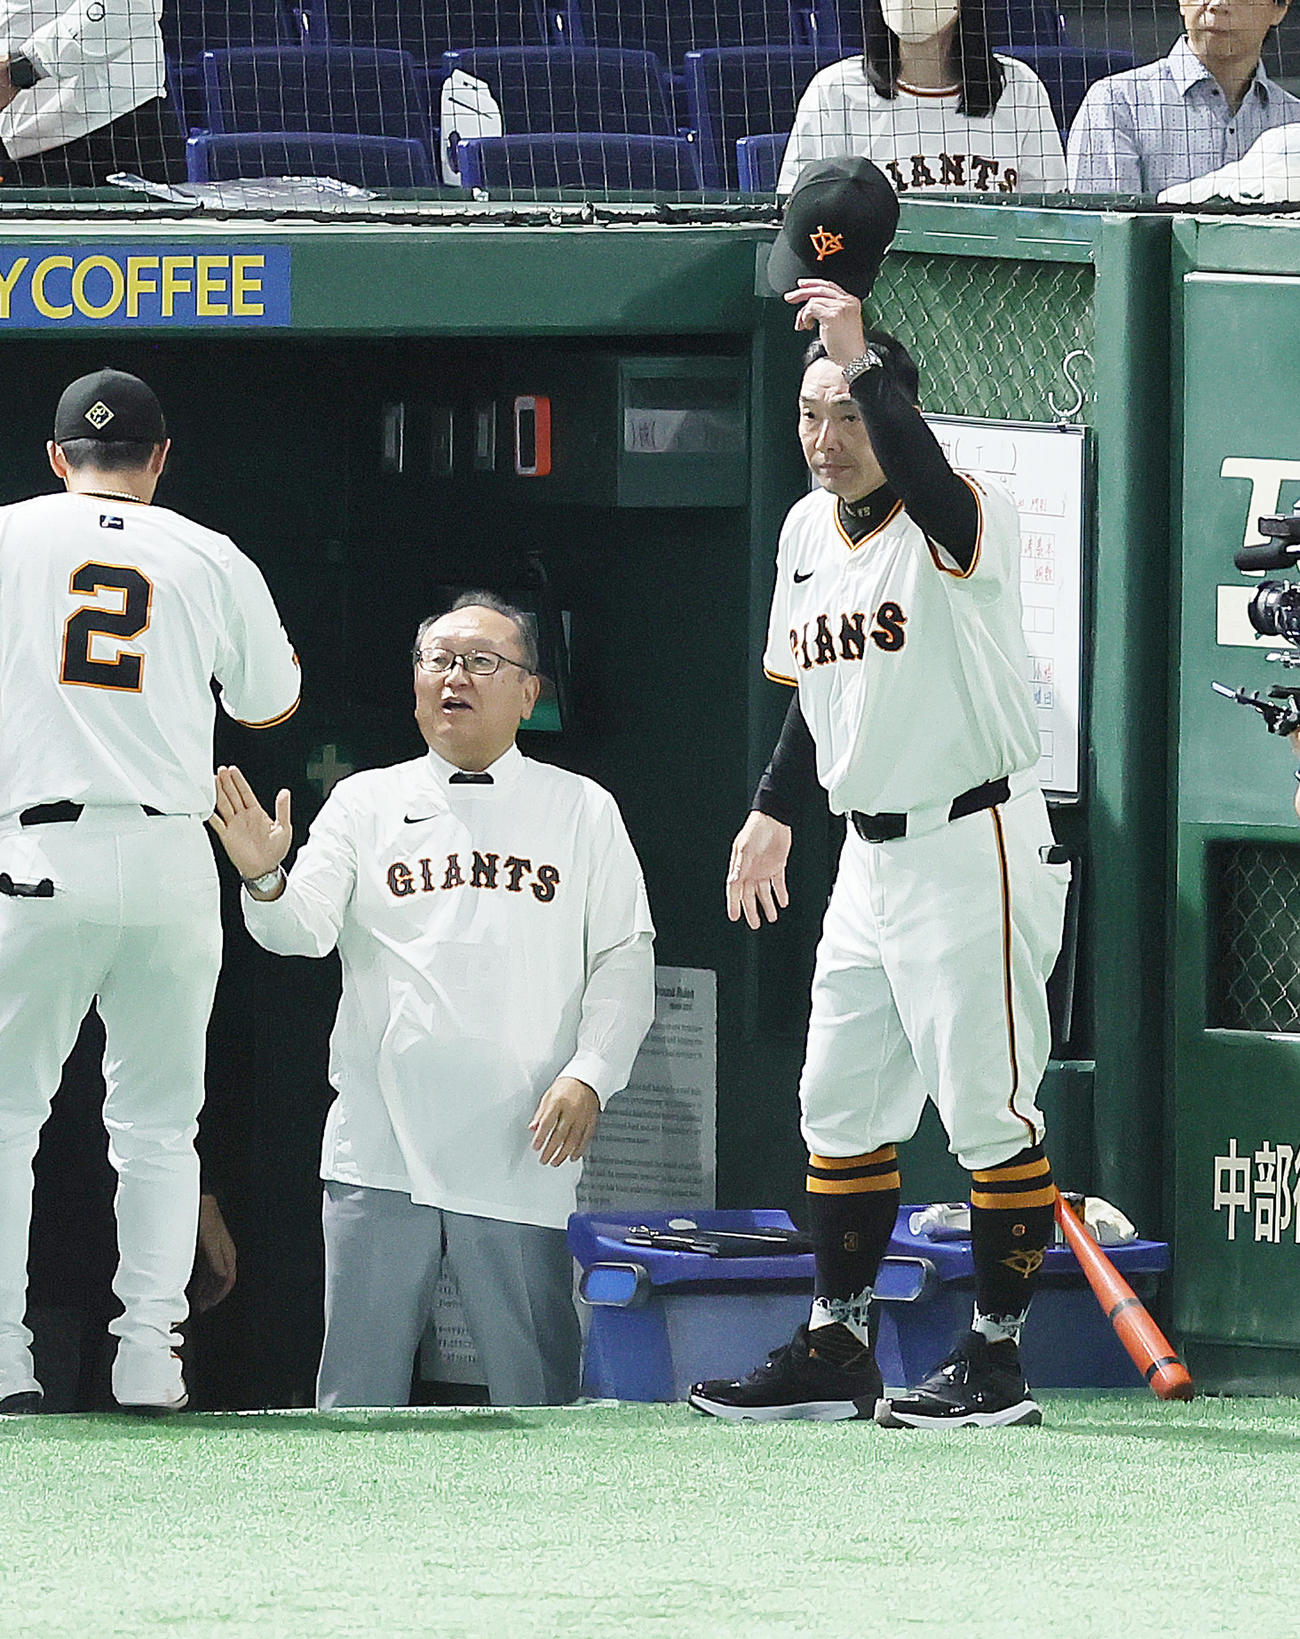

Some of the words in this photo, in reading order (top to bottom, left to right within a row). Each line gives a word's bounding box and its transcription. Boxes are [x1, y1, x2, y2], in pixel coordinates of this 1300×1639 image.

[886, 152, 1018, 193] IANTS
[59, 560, 154, 693] 2
[387, 851, 561, 903] GIANTS
